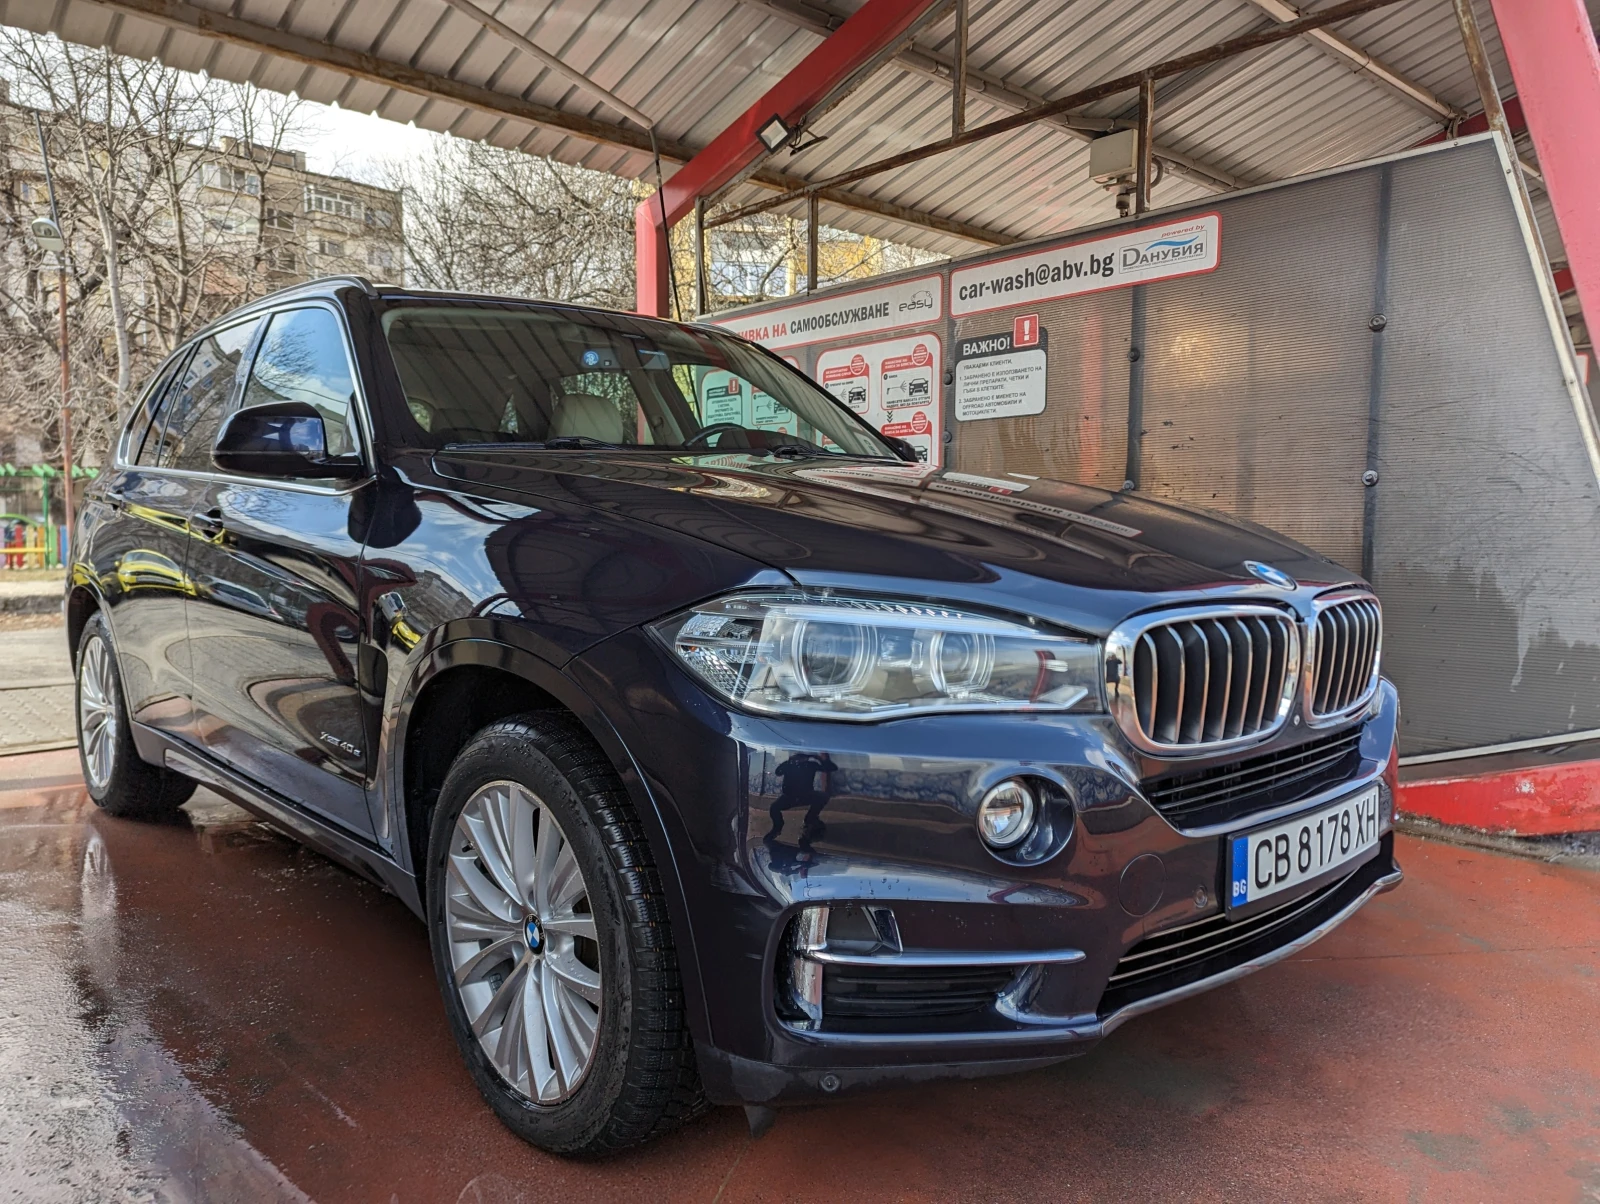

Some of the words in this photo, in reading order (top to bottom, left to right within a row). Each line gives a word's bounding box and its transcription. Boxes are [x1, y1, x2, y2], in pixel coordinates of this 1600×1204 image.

[1161, 226, 1194, 238] powered
[959, 252, 1114, 300] car-wash@abv.bg
[898, 296, 933, 312] easy
[772, 322, 788, 338] НА
[790, 302, 890, 334] САМООБСЛУЖВАНЕ
[962, 336, 1010, 356] ВАЖНО!
[964, 372, 991, 381] ЗАБРАНЕНО
[963, 396, 990, 404] ЗАБРАНЕНО
[1298, 810, 1350, 874] 8178
[1232, 879, 1246, 898] BG
